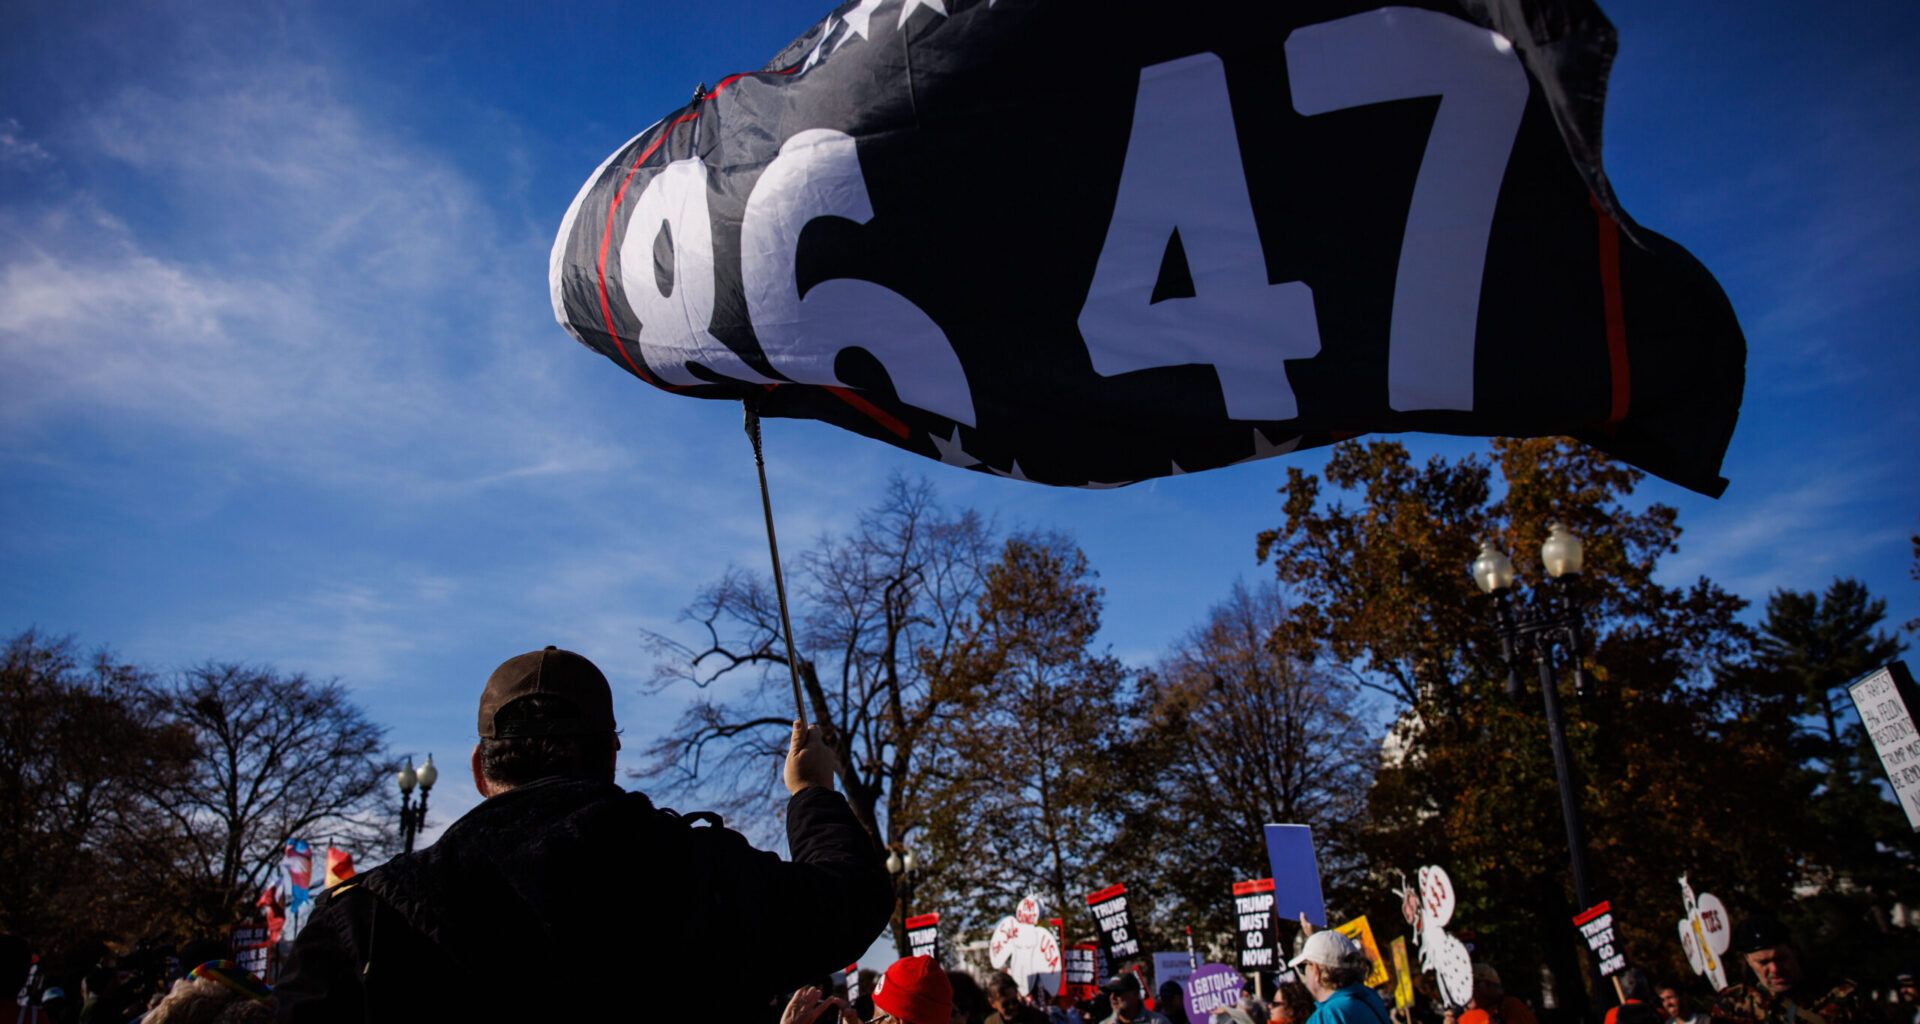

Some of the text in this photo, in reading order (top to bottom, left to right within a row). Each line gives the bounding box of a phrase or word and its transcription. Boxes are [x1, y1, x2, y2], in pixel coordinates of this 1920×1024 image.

[619, 6, 1530, 429] 86 47
[1092, 897, 1127, 919] TRUMP
[1235, 894, 1274, 914] TRUMP
[1100, 911, 1128, 933] MUST
[1239, 912, 1270, 931] MUST
[1578, 913, 1613, 939] TRUMP
[908, 927, 937, 947] TRUMP
[1111, 928, 1128, 943] GO
[1246, 931, 1264, 948] GO
[1587, 927, 1615, 952] MUST
[1040, 934, 1059, 975] USA
[1110, 939, 1139, 959] NOW!
[1242, 948, 1273, 966] NOW!
[1598, 943, 1615, 960] GO
[1598, 953, 1626, 976] NOW!
[1187, 971, 1239, 997] LGBTQIA+
[1191, 988, 1241, 1015] EQUALITY
